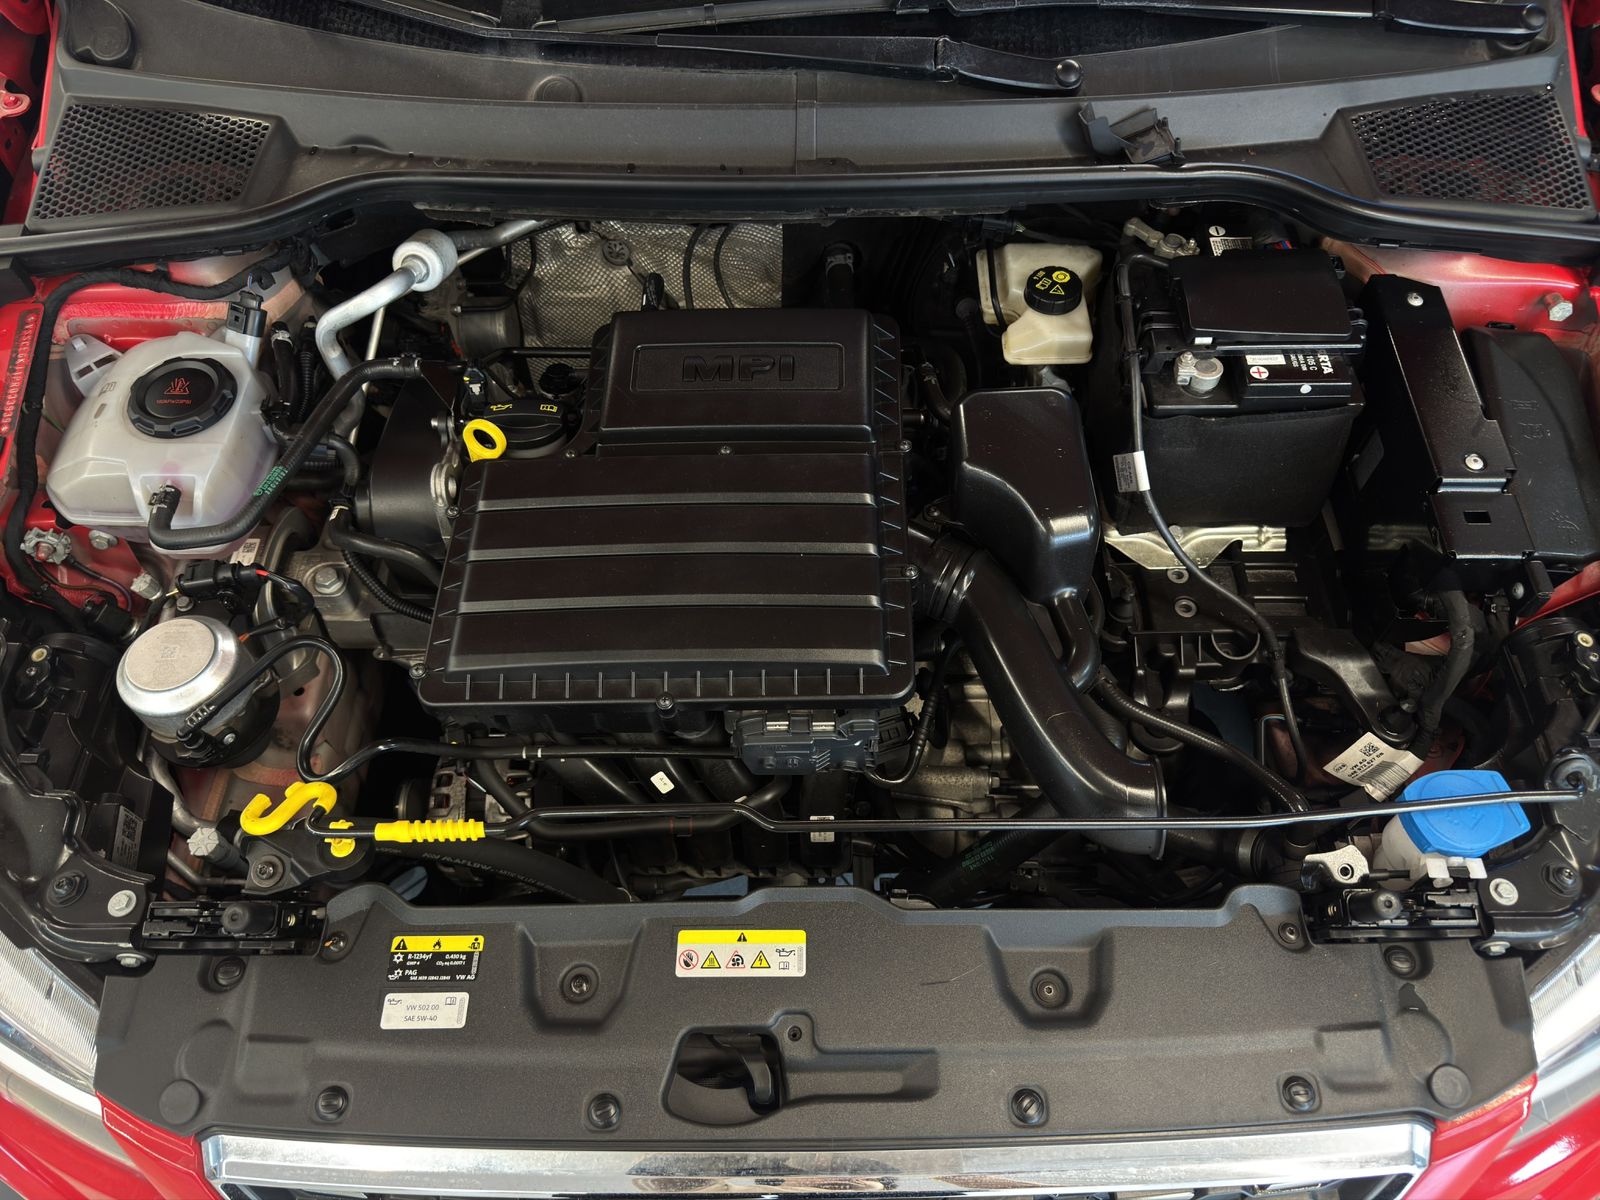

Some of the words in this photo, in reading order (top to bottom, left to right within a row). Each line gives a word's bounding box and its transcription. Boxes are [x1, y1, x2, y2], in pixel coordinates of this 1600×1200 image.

[682, 355, 795, 382] MPI
[1317, 353, 1334, 375] RTA
[1350, 763, 1358, 771] VW
[407, 953, 433, 961] R-1234yf
[459, 953, 467, 961] kg
